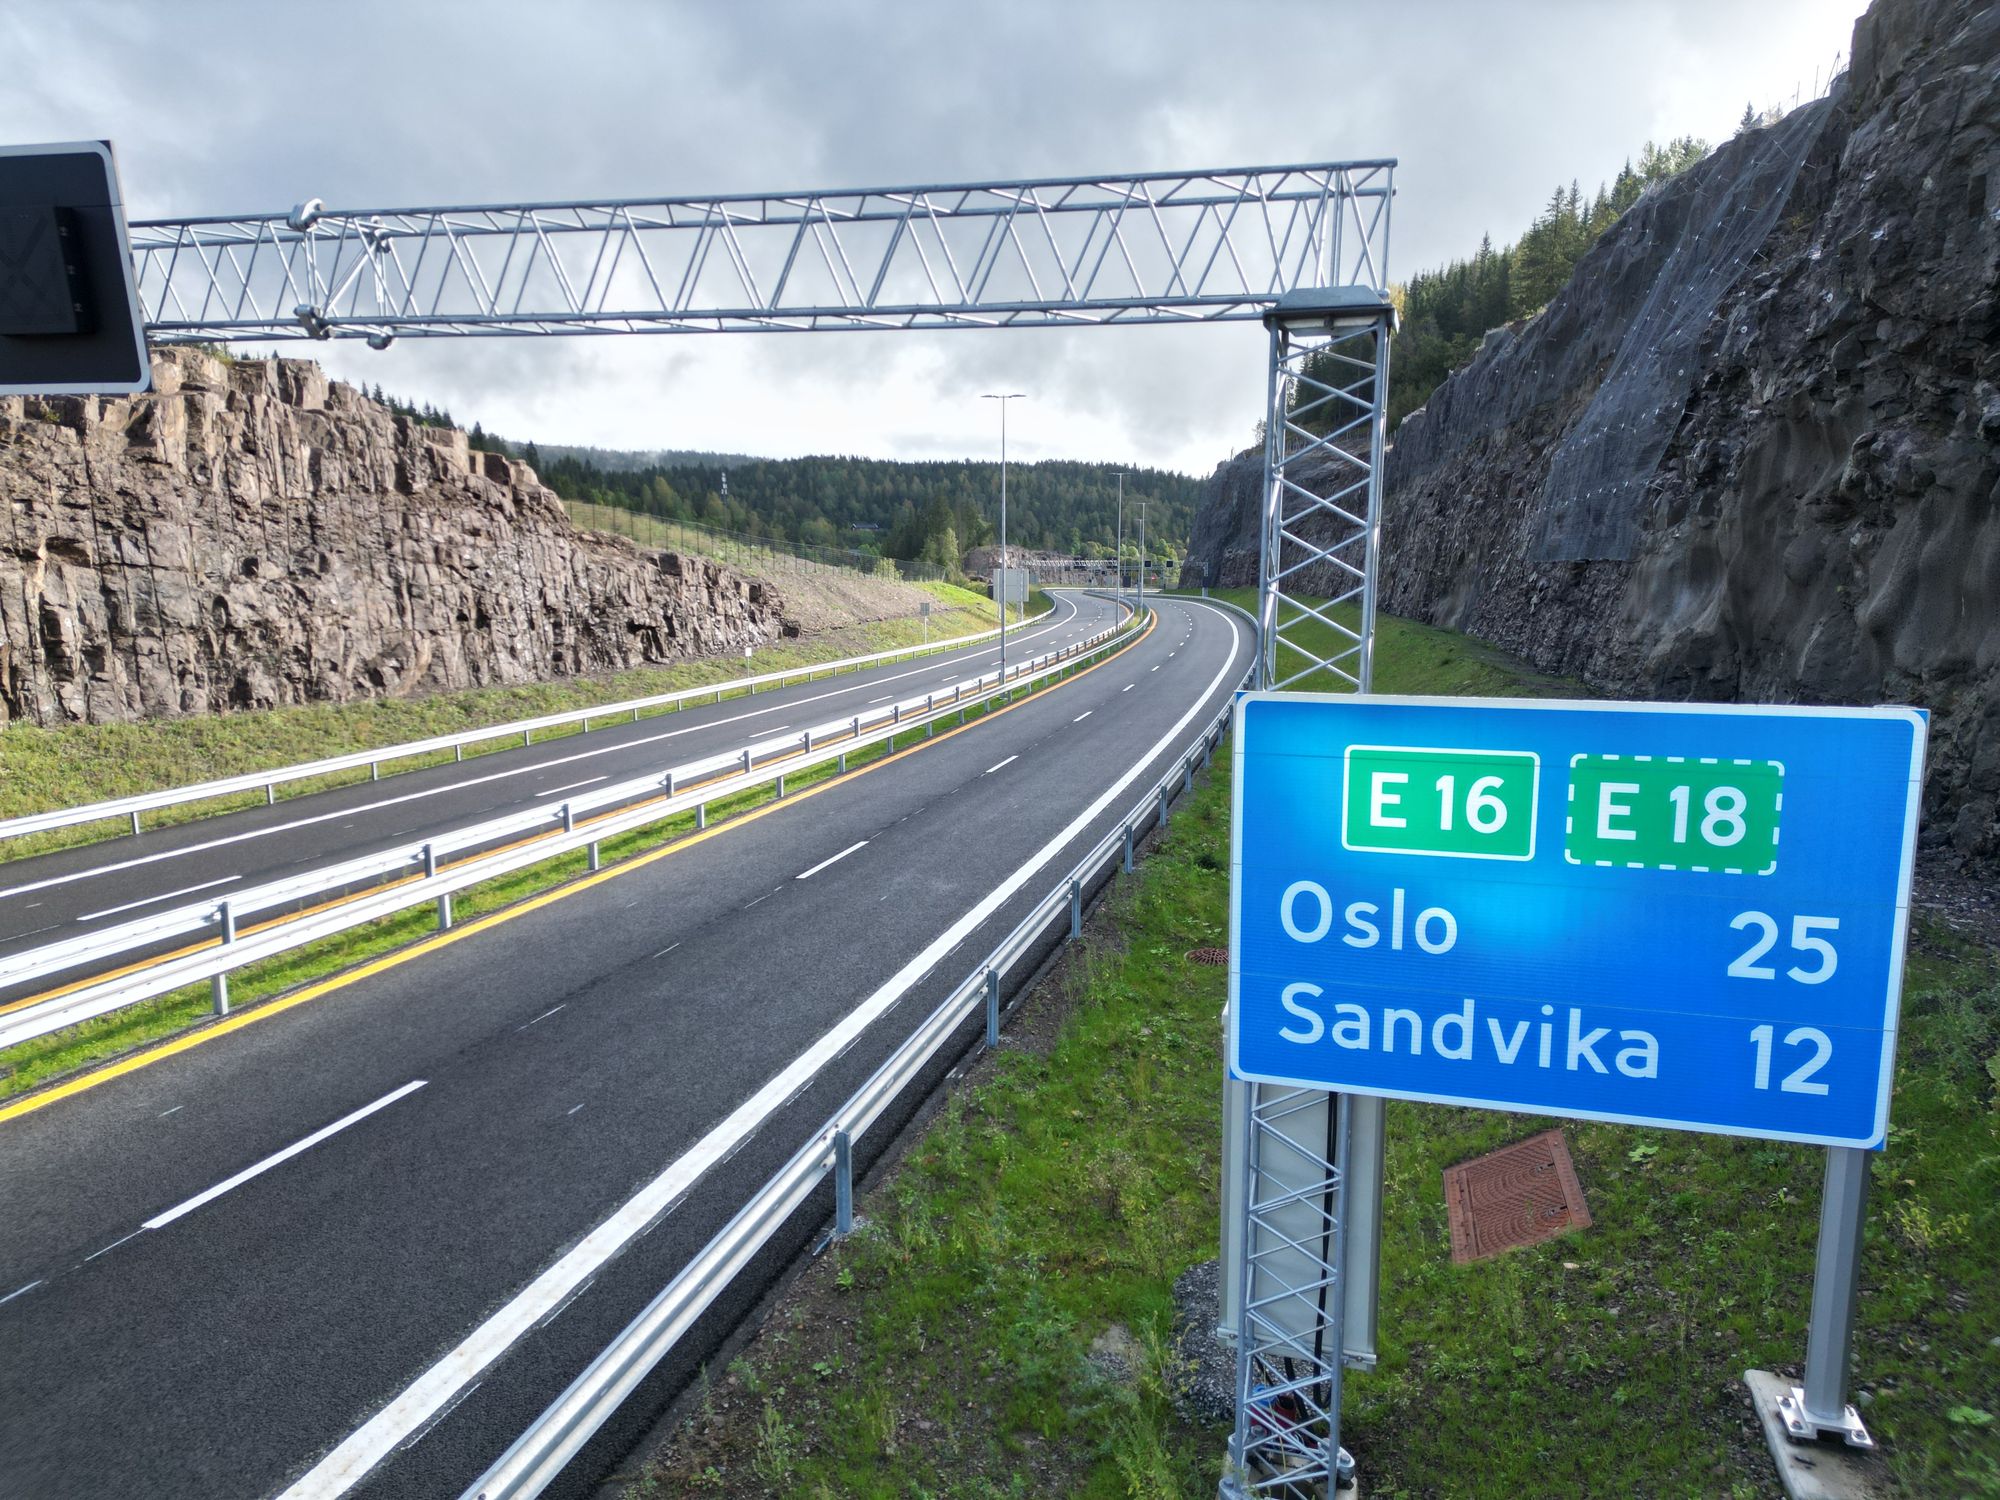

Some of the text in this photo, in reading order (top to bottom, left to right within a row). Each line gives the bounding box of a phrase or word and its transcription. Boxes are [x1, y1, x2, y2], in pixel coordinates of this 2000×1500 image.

[1369, 771, 1508, 834] E 16
[1596, 782, 1747, 847] E 18
[1280, 880, 1840, 984] Oslo 25
[1279, 982, 1833, 1096] Sandvika 12
